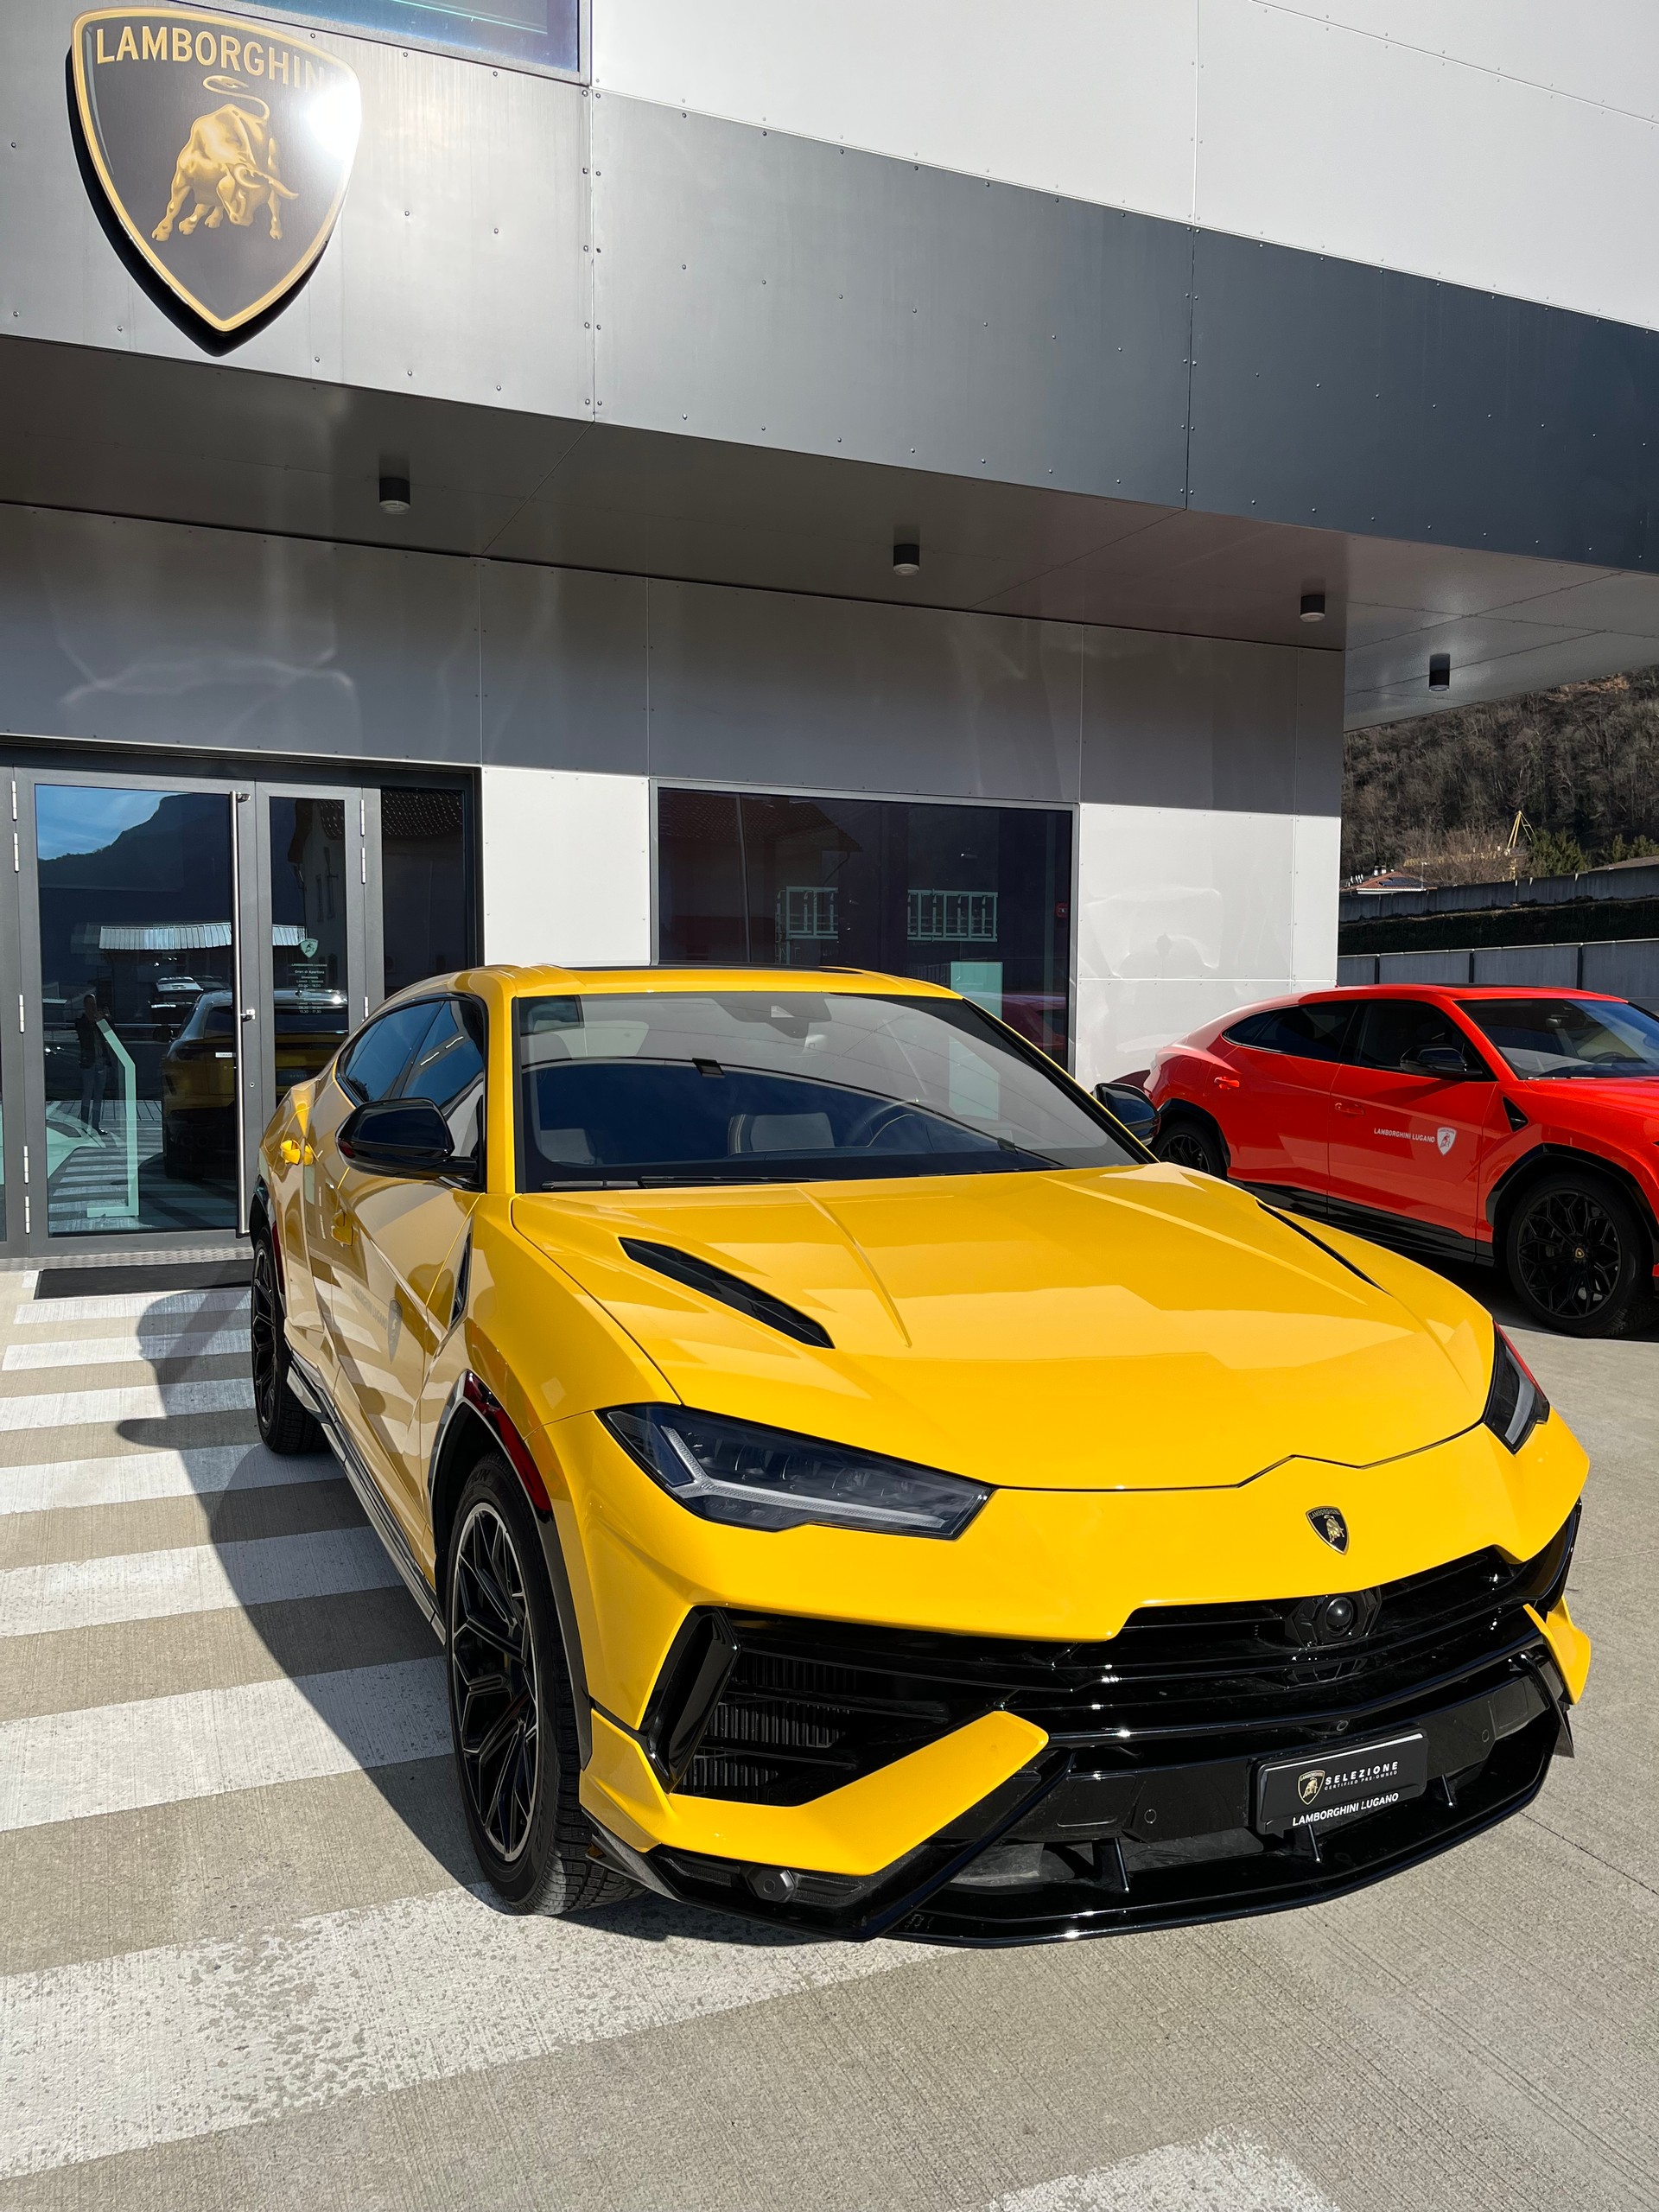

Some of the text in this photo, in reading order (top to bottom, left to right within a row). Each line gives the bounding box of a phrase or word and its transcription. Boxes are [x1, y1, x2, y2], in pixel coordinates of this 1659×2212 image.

[1374, 1128, 1435, 1143] LAMBORGHINI LUGANO
[1325, 1762, 1398, 1785] SELEZIONE
[1325, 1770, 1398, 1790] CERTIFIED PRE-OWNED
[1292, 1792, 1400, 1827] LAMBORGHINI LUGANO
